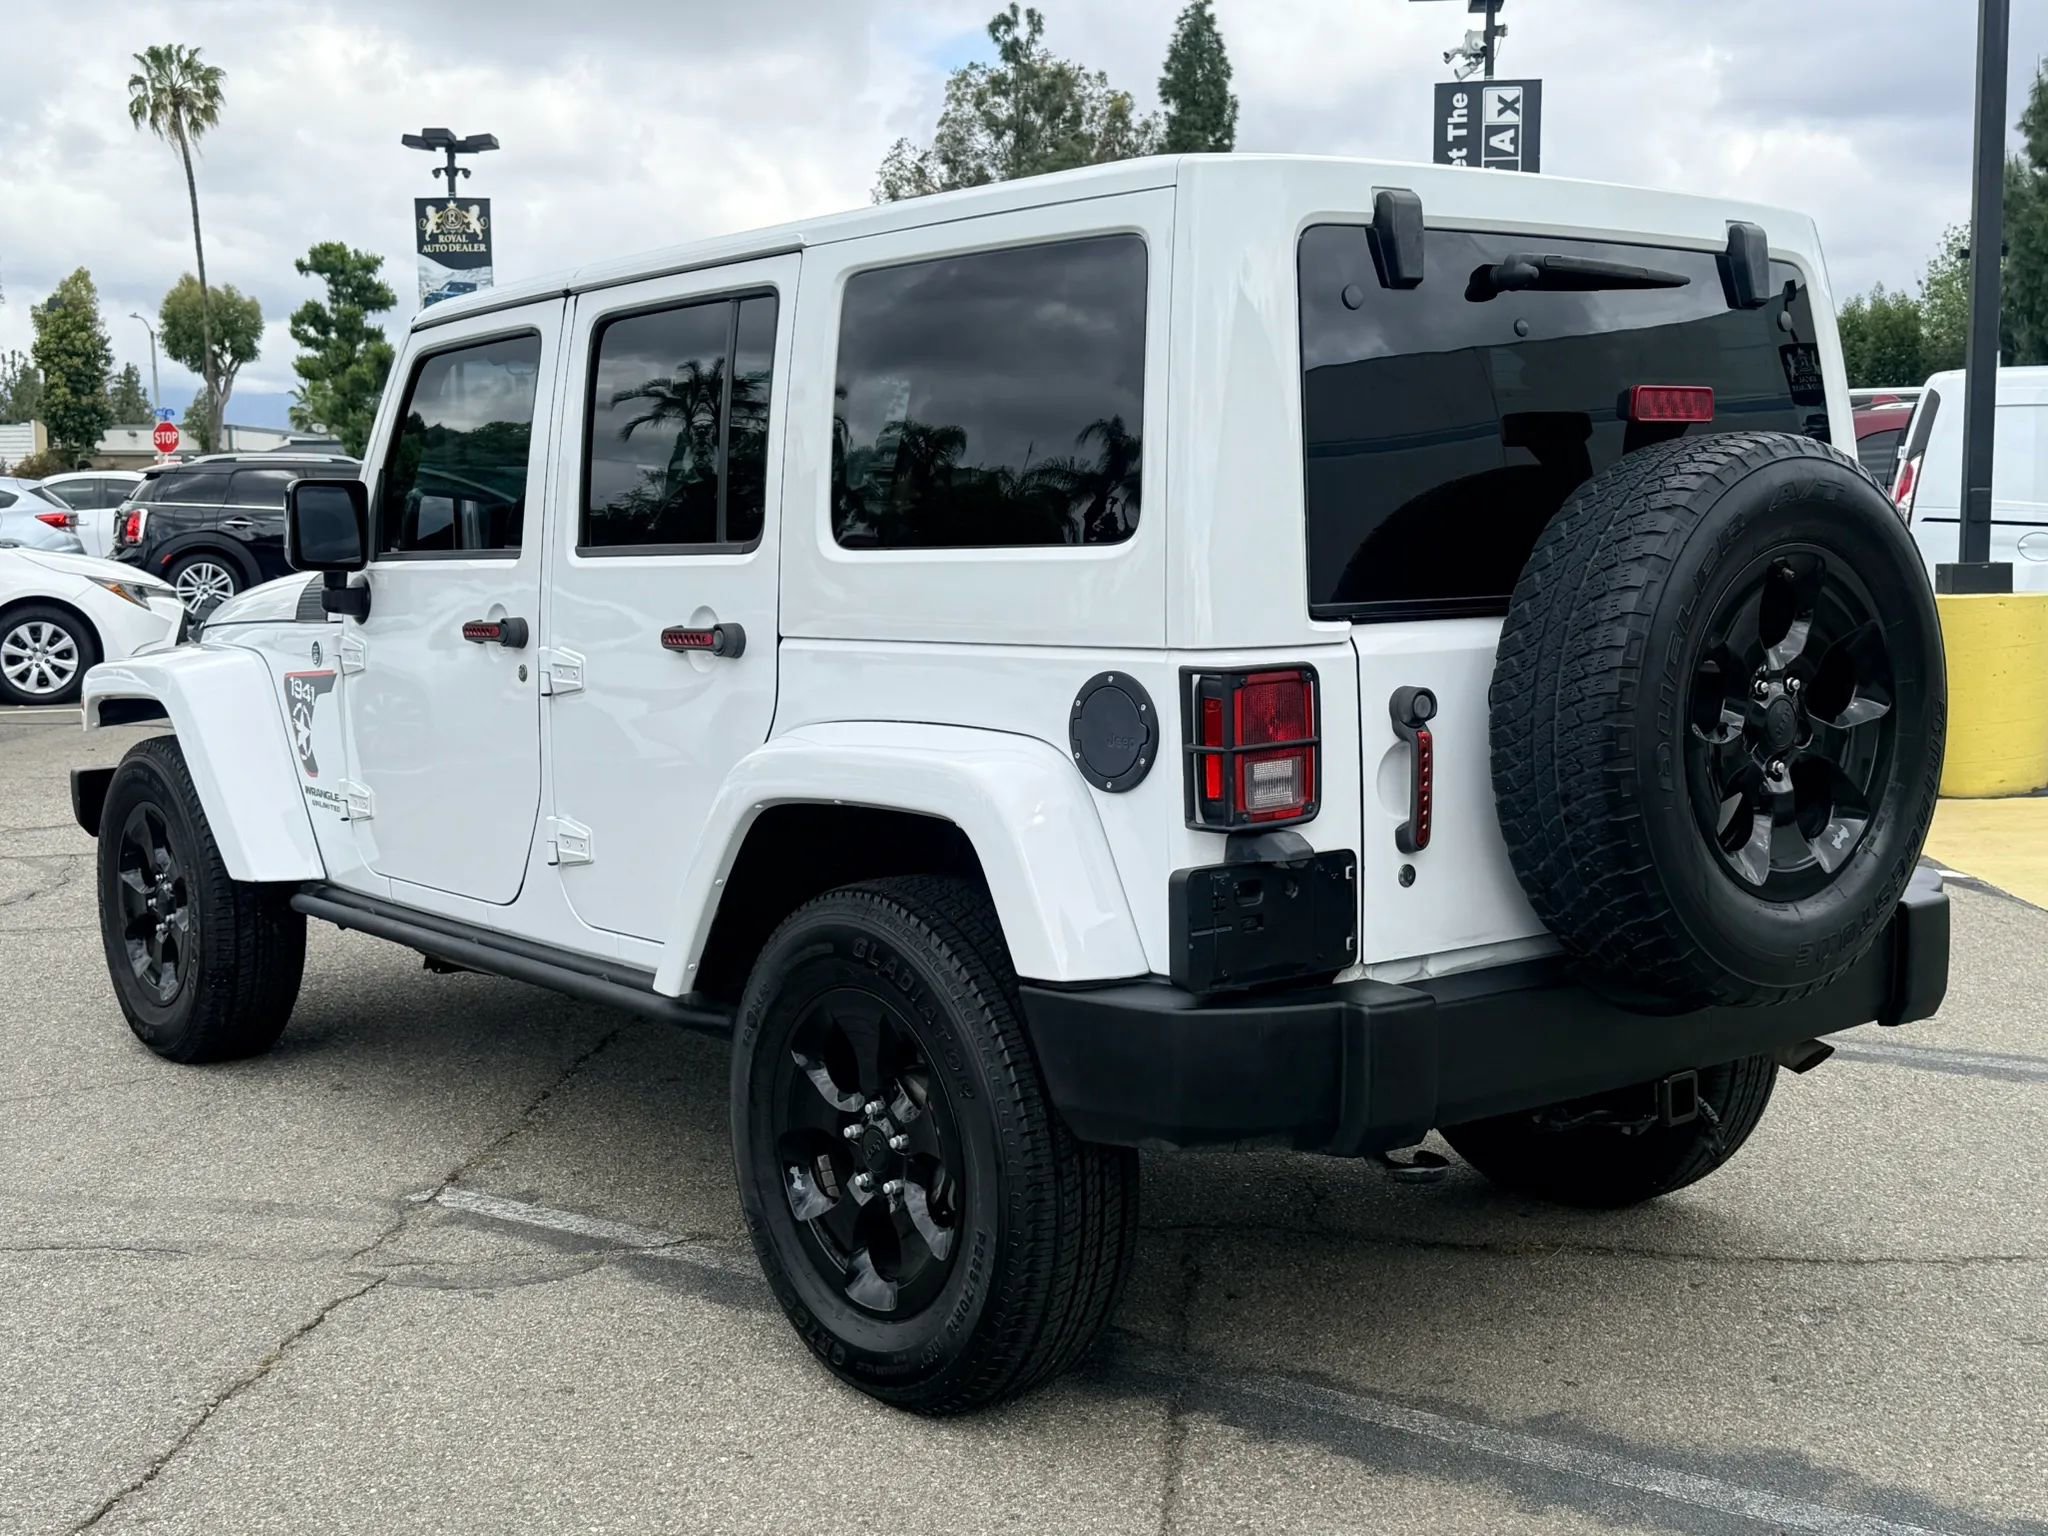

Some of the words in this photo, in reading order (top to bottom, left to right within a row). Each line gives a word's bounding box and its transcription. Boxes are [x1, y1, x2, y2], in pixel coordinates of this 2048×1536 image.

[1447, 92, 1469, 142] The
[1489, 94, 1521, 169] AX
[422, 245, 448, 253] AUTO
[448, 243, 487, 253] DEALER
[438, 234, 469, 243] ROYAL
[154, 431, 178, 445] STOP
[289, 676, 316, 707] 1941
[852, 936, 976, 1100] GLADIATOR
